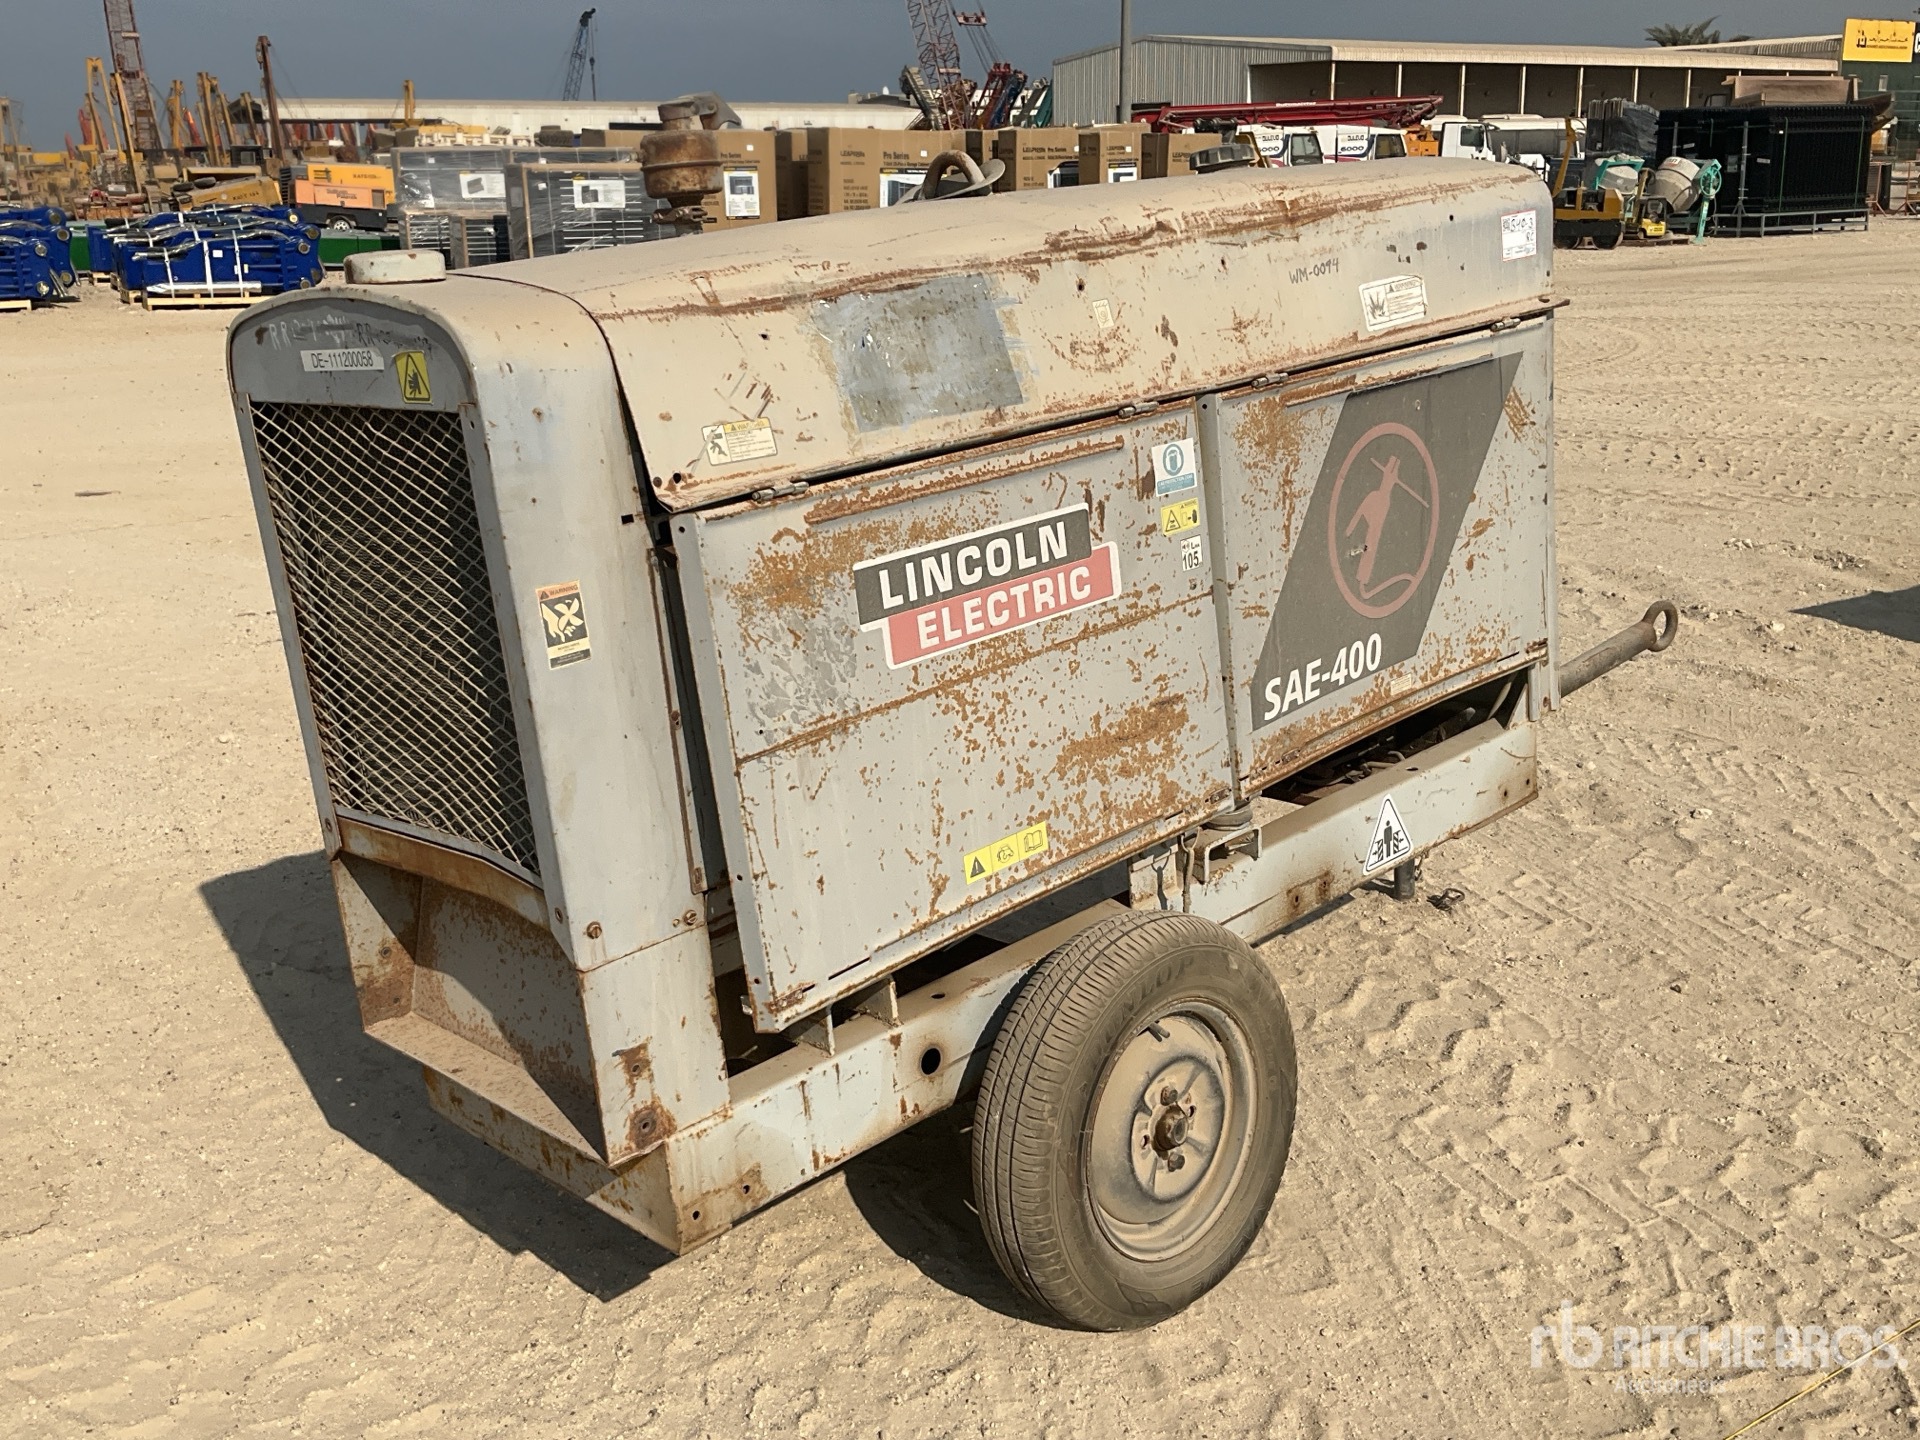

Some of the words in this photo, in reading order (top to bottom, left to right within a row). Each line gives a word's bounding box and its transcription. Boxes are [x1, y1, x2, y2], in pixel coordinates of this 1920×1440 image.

[1288, 257, 1340, 285] WM-0094
[310, 352, 374, 369] DE-111200058
[878, 521, 1068, 610] LINCOLN
[1183, 551, 1199, 570] 105
[549, 585, 578, 595] WARNING
[917, 566, 1091, 650] ELECTRIC
[1264, 632, 1382, 721] SAE-400
